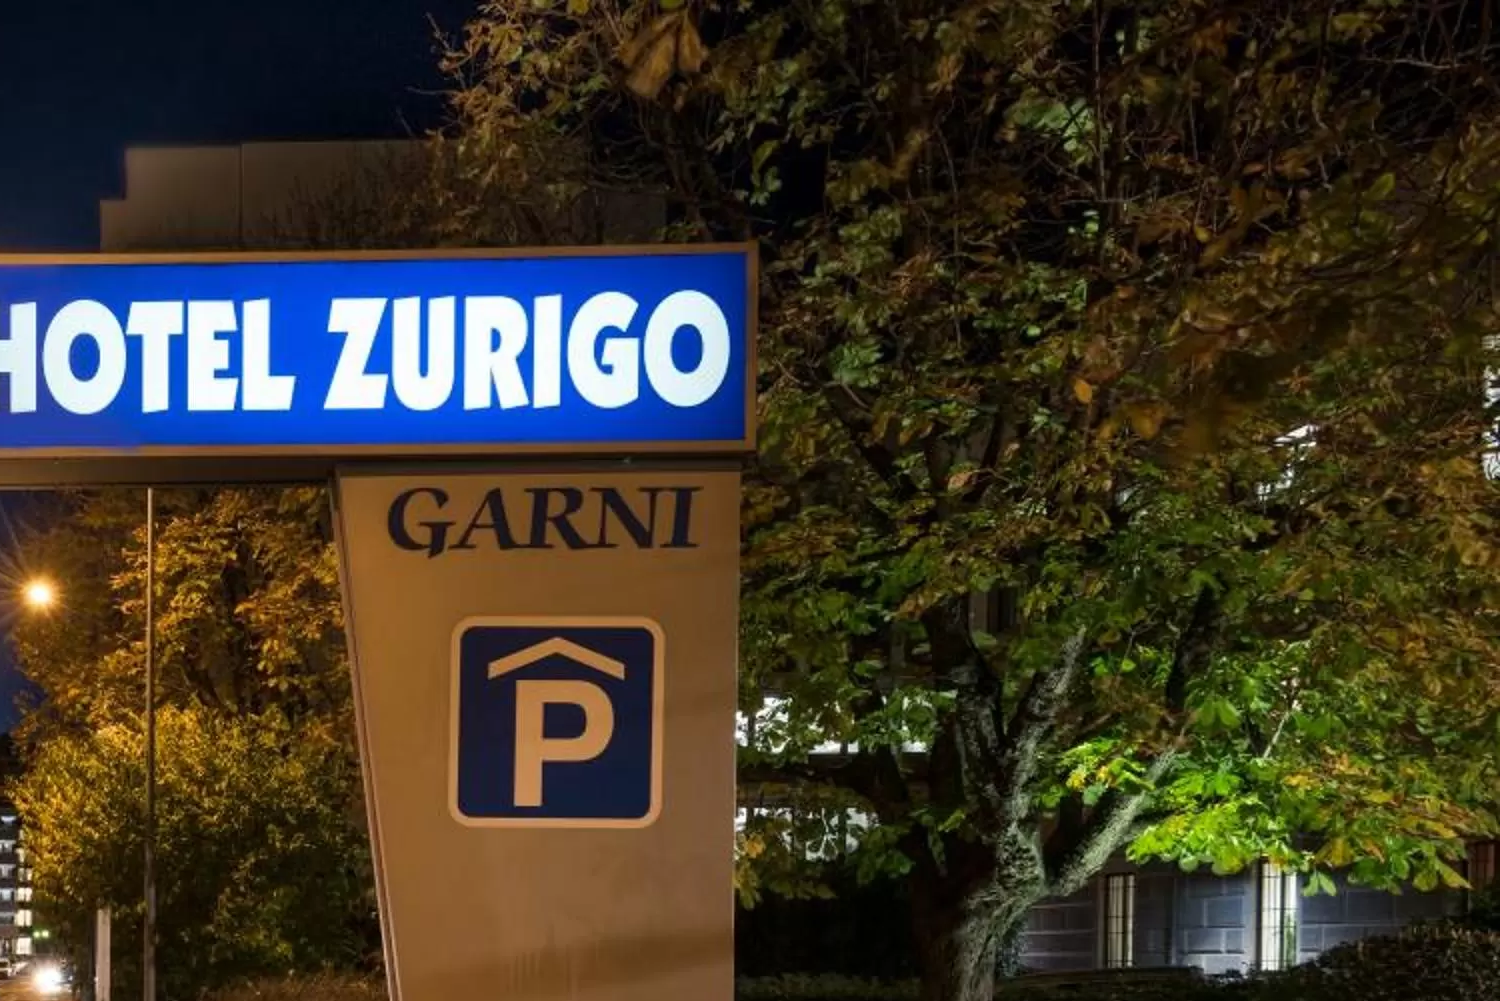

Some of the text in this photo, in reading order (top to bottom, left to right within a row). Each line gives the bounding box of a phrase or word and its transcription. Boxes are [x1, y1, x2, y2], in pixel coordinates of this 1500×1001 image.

[324, 290, 731, 411] ZURIGO
[387, 487, 704, 559] GARNI
[513, 679, 615, 808] P
